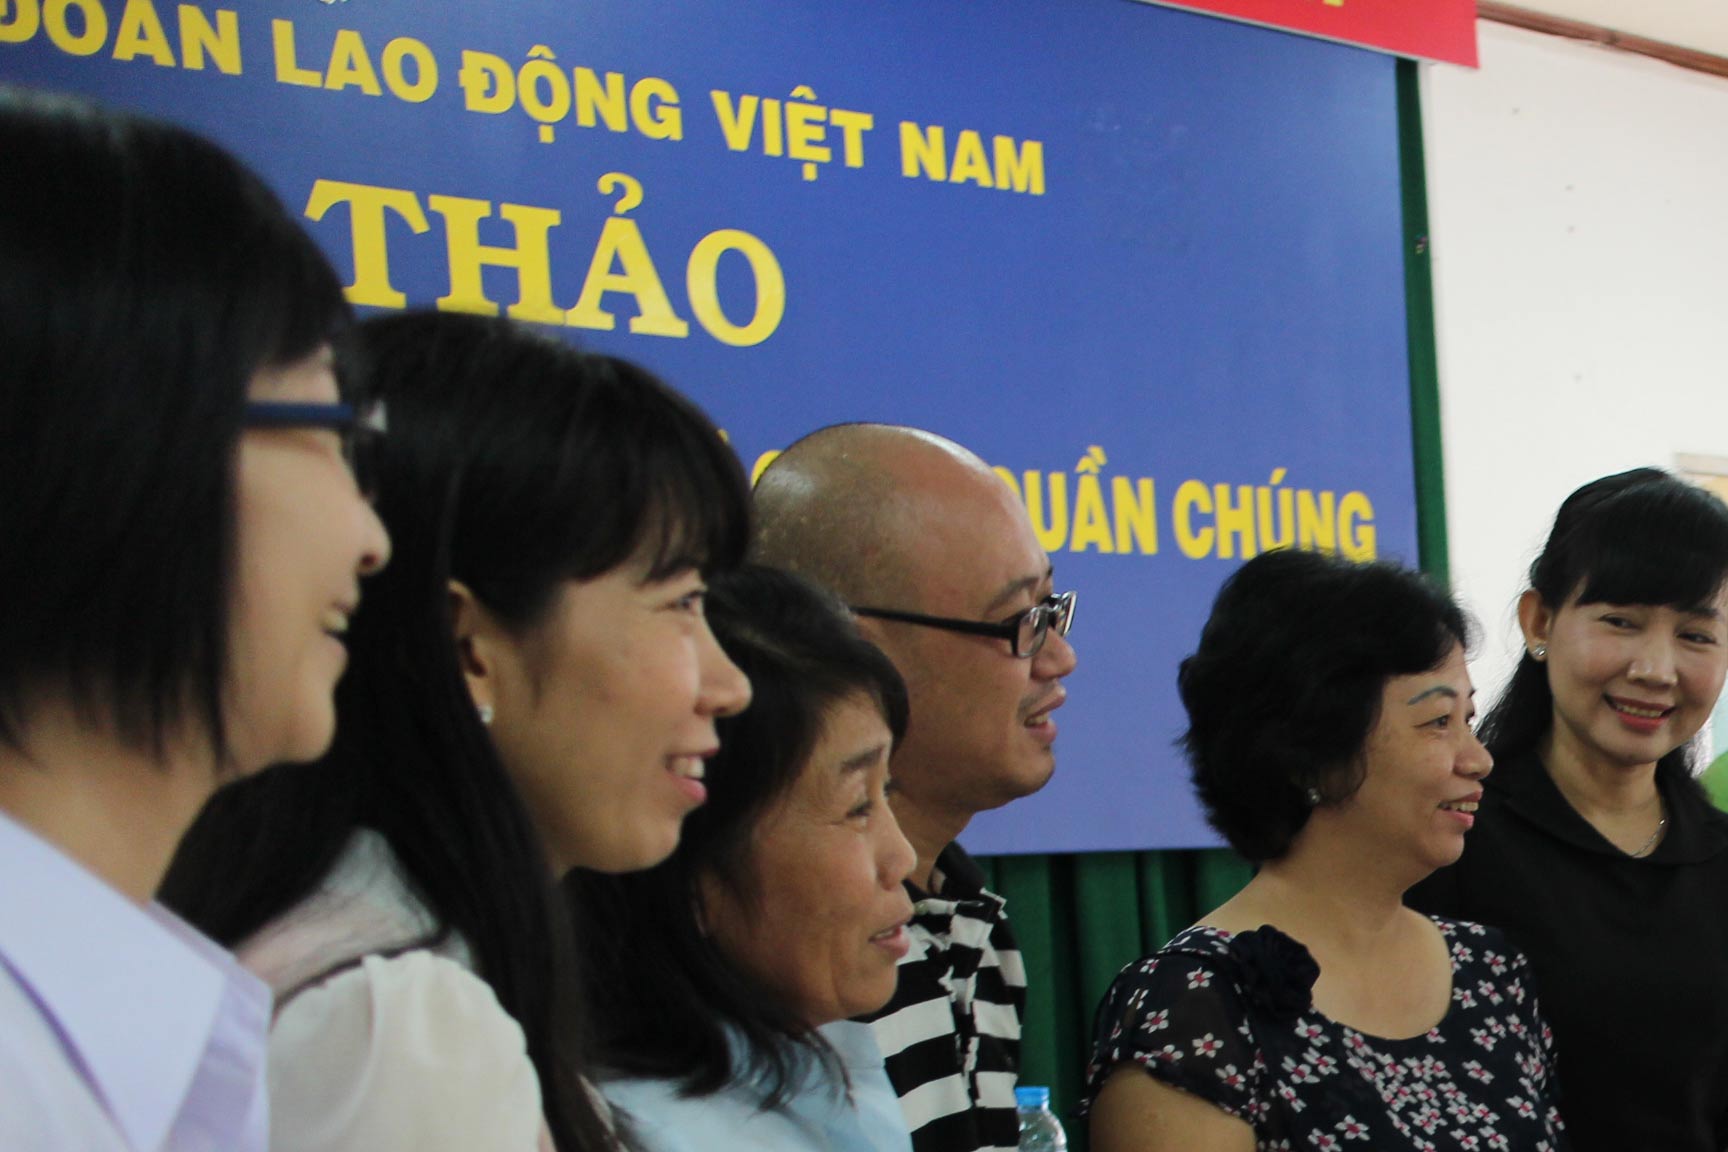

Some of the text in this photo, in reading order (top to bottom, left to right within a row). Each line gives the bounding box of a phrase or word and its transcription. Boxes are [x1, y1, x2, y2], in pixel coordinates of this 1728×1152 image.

[272, 18, 439, 104] LAO
[457, 43, 684, 144] ĐỘNG
[711, 85, 874, 181] VIỆT
[900, 121, 1045, 195] NAM
[303, 172, 787, 348] THẢO
[992, 445, 1377, 566] UẦN CHÚNG
